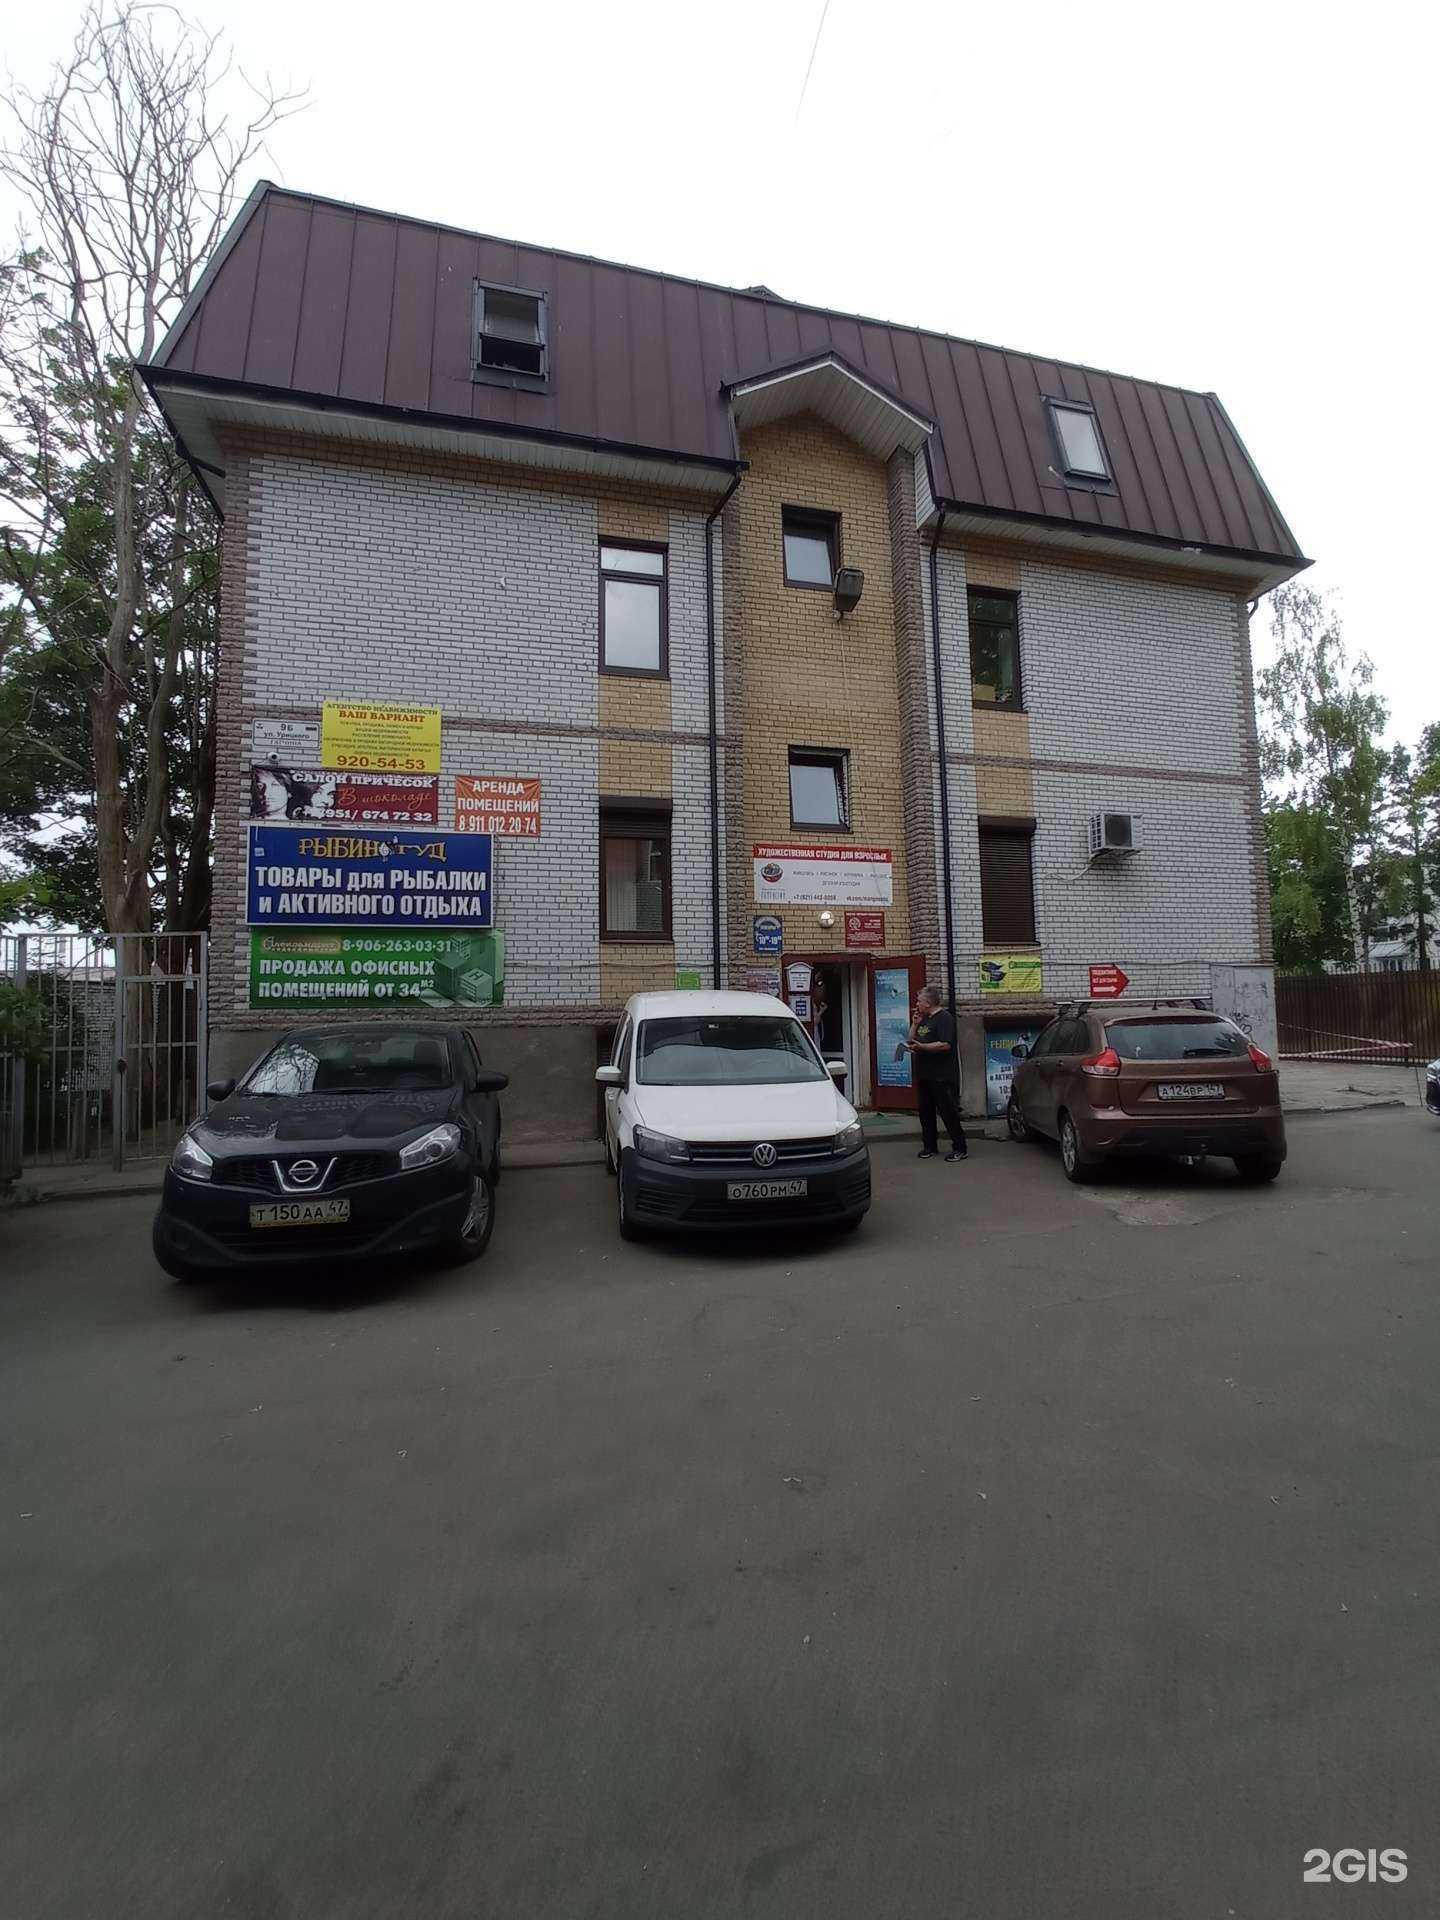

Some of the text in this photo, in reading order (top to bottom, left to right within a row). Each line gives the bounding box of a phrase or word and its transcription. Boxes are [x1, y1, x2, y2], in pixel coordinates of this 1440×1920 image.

[339, 710, 426, 723] ВАШ ВАРИАНТ
[337, 755, 426, 770] 920-54-53
[292, 772, 433, 788] САЛОН ПРИЧЕСОК
[472, 780, 525, 796] АРЕНДА
[457, 798, 539, 813] ПОМЕЩЕНИЙ
[362, 810, 389, 821] 674
[393, 811, 412, 822] 72
[414, 812, 433, 822] 32
[459, 814, 537, 834] 8 911 012 20 74
[398, 841, 447, 862] ГУД
[758, 848, 887, 860] ХУДОЖЕСТВЕННАЯ СТУДИЯ ДЛЯ ВЗРОСЛЫХ
[255, 866, 487, 891] ТОВАРЫ для РЫБАЛКИ
[259, 893, 483, 918] и АКТИВНОГО ОТДЫХА
[259, 959, 436, 977] ПРОДАЖА ОФИСНЫХ
[259, 979, 369, 1000] ПОМЕЩЕНИЙ
[374, 983, 395, 997] ОТ
